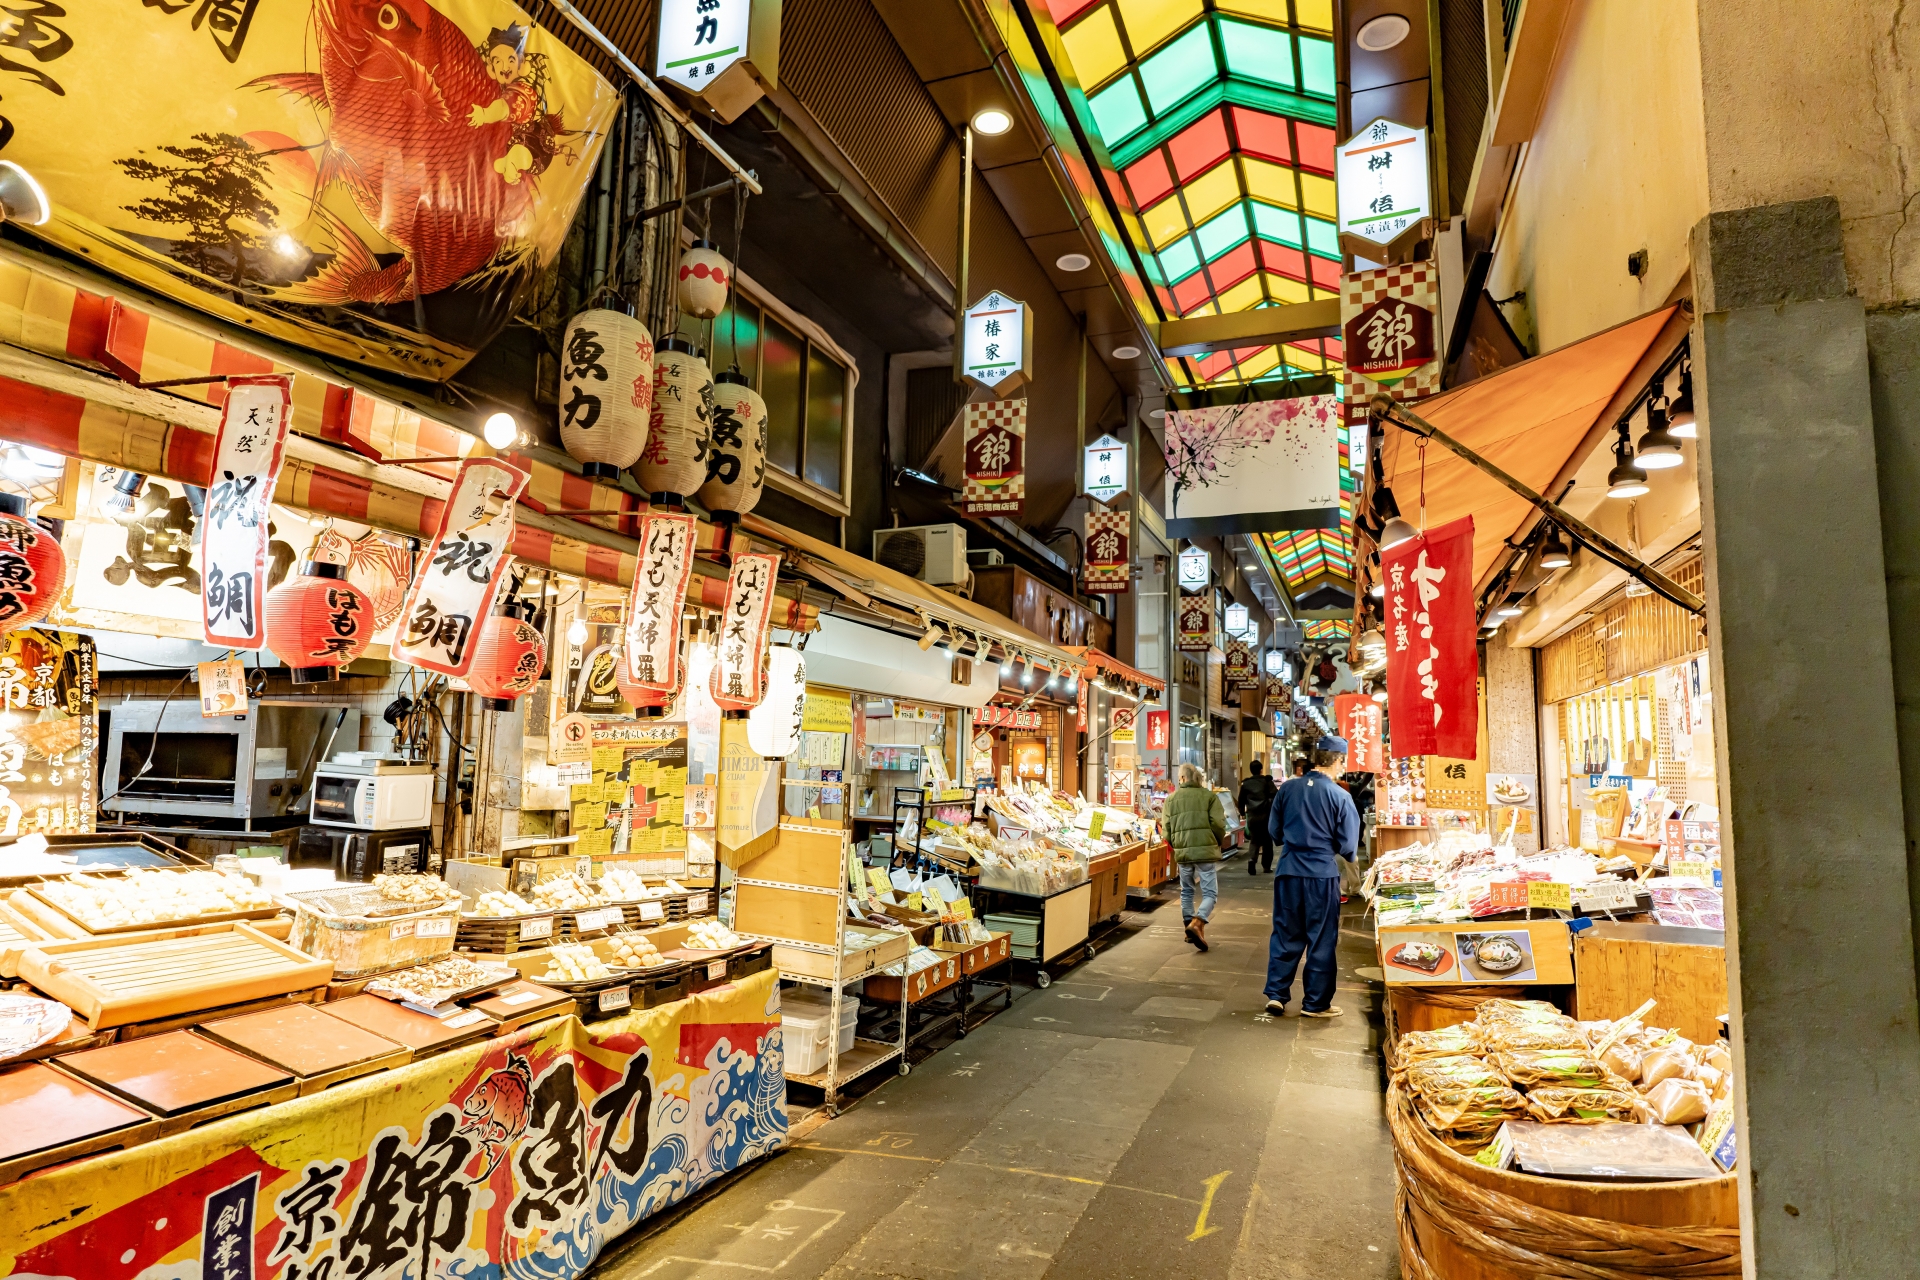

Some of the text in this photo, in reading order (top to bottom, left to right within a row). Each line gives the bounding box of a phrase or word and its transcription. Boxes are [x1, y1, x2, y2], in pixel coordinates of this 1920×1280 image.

[688, 63, 715, 78] 焼魚
[1369, 122, 1389, 143] 錦
[1364, 218, 1406, 235] 京漬物
[986, 295, 1000, 309] 錦
[985, 319, 1002, 361] 椿家
[1356, 304, 1416, 369] 錦
[564, 328, 609, 429] 魚力
[665, 363, 682, 402] 名代
[1363, 358, 1397, 370] NISHIKI
[235, 408, 260, 453] 天然
[736, 401, 752, 419] 錦
[704, 405, 744, 485] 魚力
[973, 431, 1011, 477] 錦
[967, 501, 1019, 513] 錦市場商店街
[207, 471, 258, 636] 祝鯛
[1091, 531, 1119, 564] 錦
[400, 531, 493, 666] 祝鯛
[634, 528, 676, 684] はも天婦羅
[1390, 562, 1410, 652] 京名産
[724, 566, 758, 698] はも天婦羅
[1184, 611, 1204, 633] 錦
[31, 663, 57, 708] 京都
[80, 643, 93, 704] 創業大正8年
[1348, 702, 1370, 767] 千枚漬
[48, 752, 64, 787] はも
[1669, 824, 1682, 861] お買い得品
[603, 993, 625, 1004] ¥500
